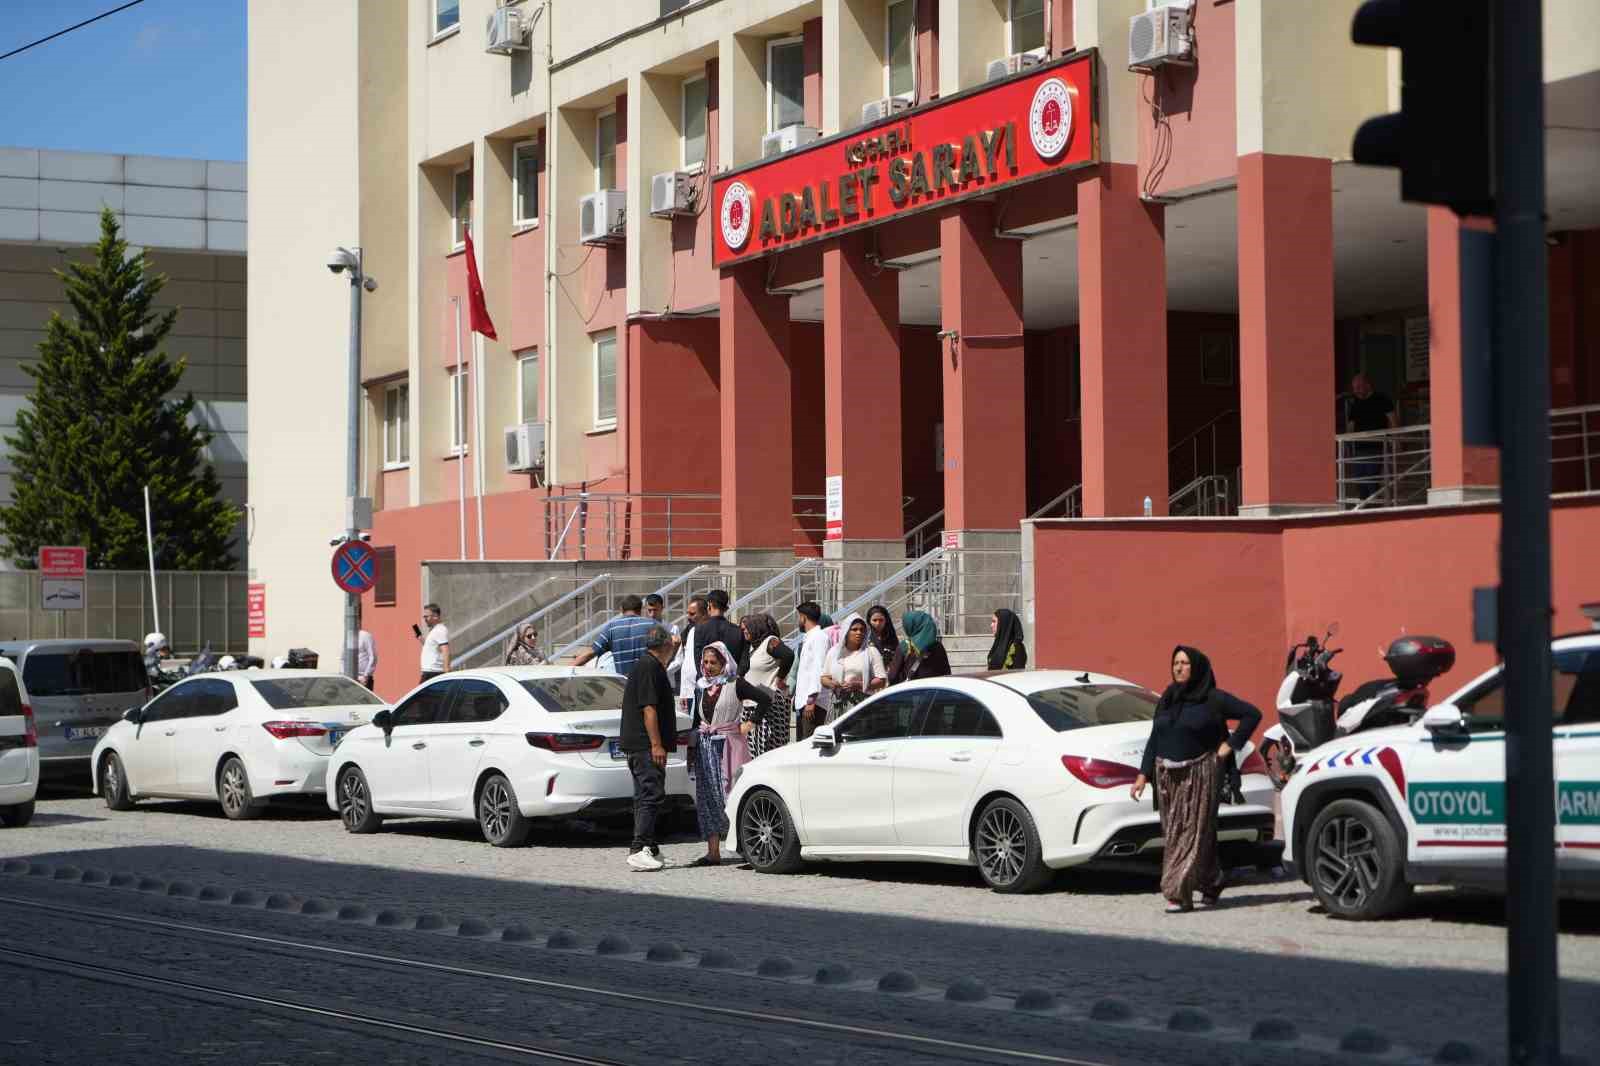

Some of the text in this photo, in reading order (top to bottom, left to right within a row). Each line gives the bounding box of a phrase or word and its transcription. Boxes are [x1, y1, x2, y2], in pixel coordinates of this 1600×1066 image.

[759, 121, 1018, 243] ADALET SARAYI
[1414, 790, 1493, 816] OTOYOL
